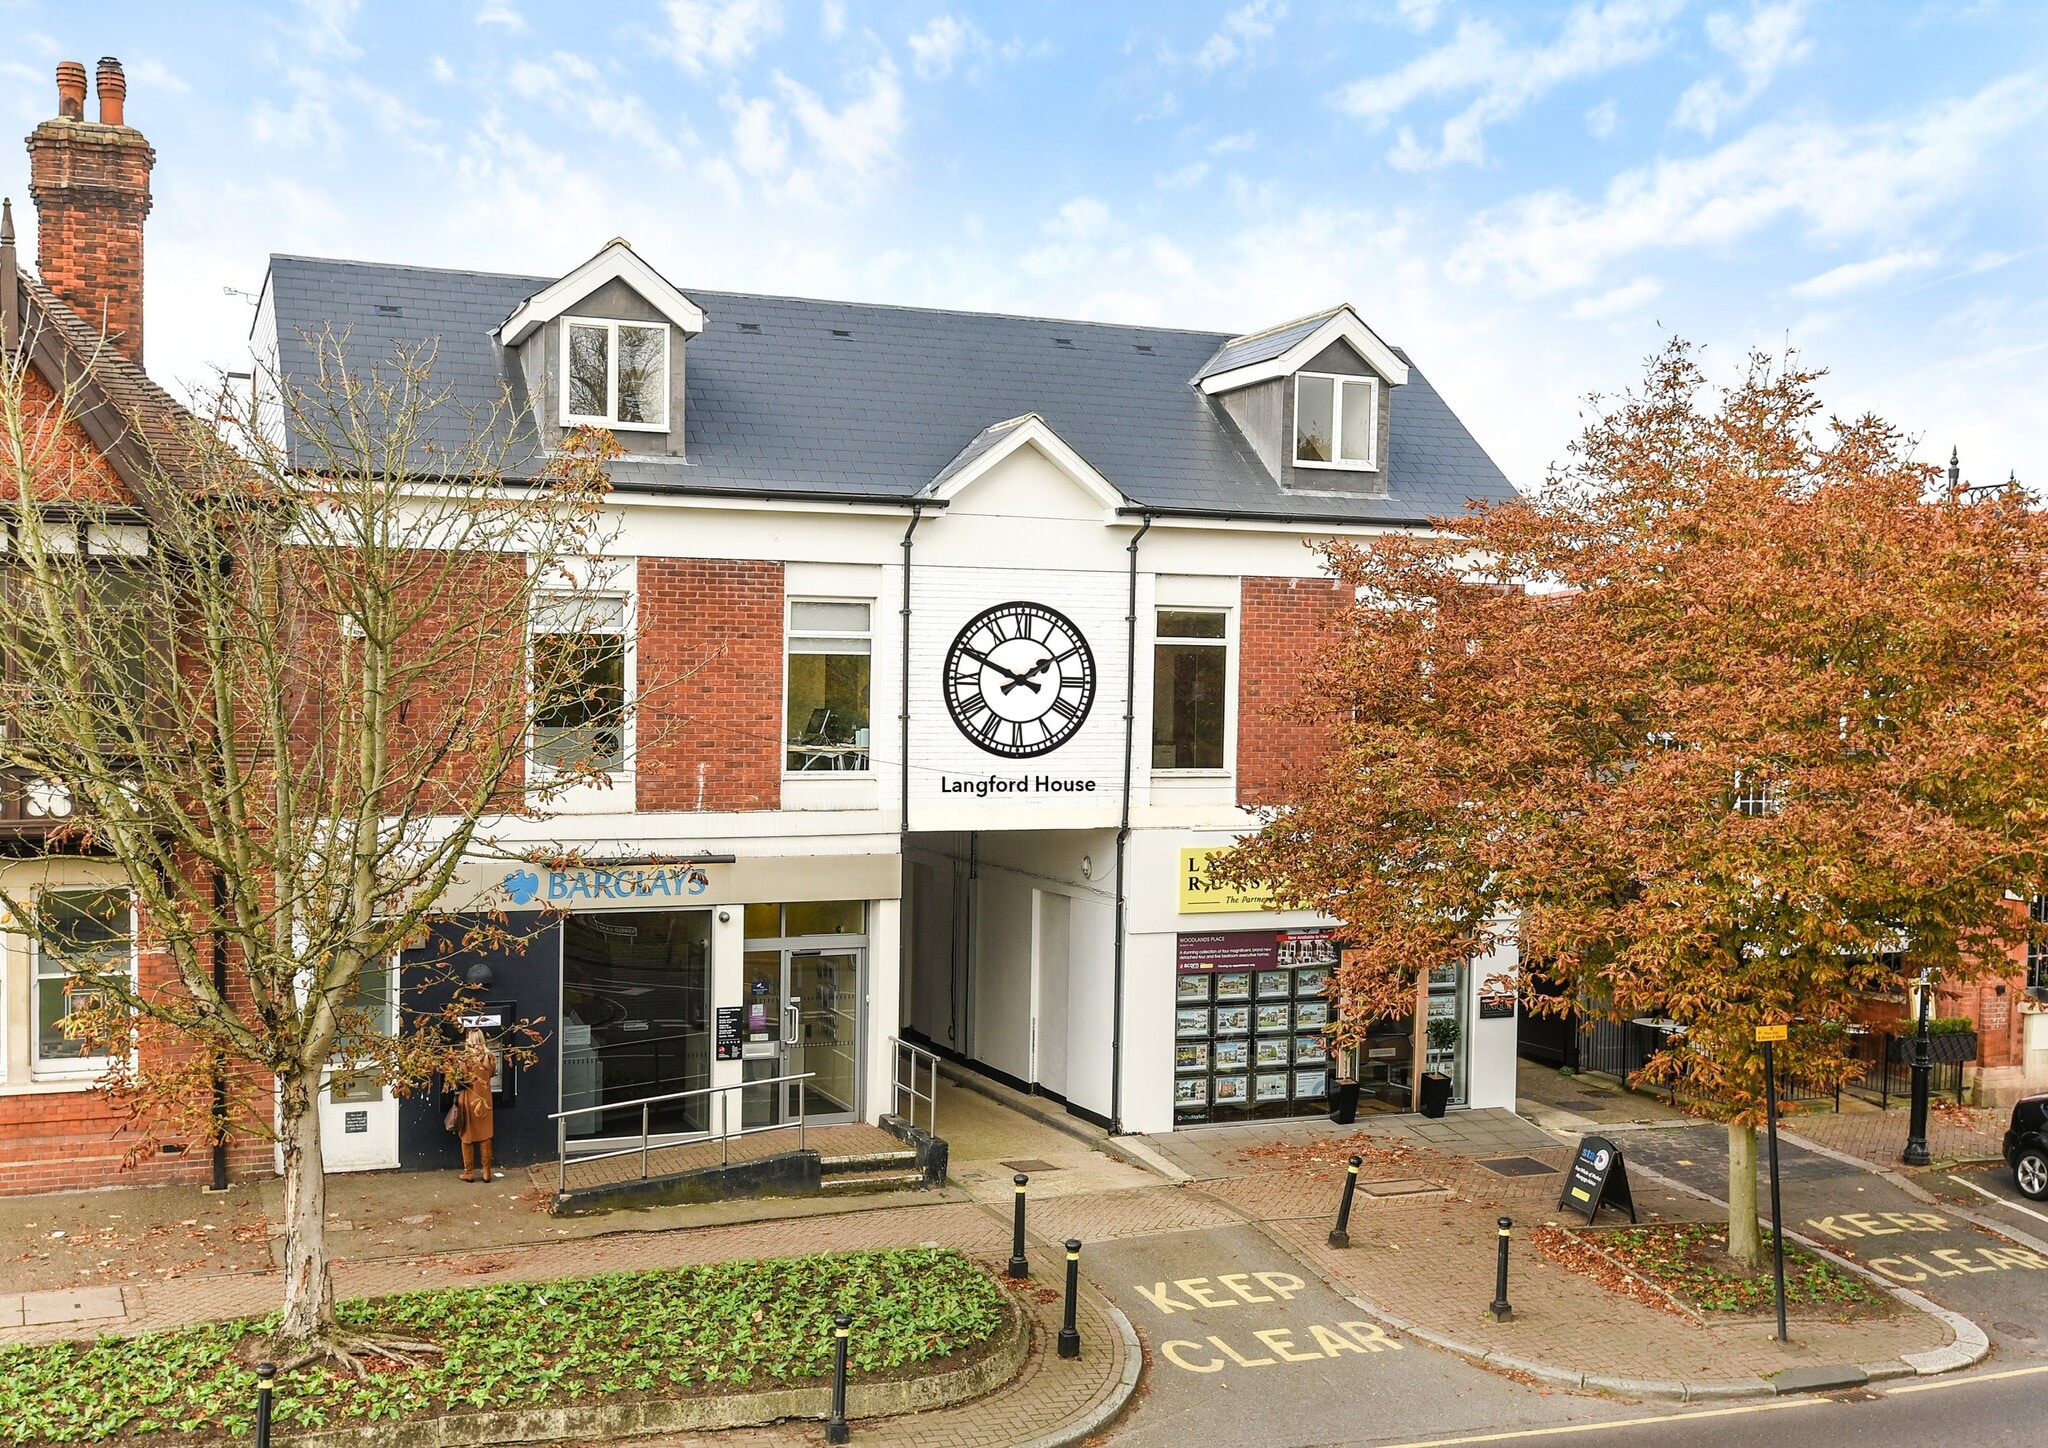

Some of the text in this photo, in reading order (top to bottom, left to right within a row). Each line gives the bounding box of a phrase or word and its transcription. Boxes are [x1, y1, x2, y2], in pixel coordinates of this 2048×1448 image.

[942, 775, 1096, 797] Langford House
[548, 868, 706, 900] BARCLAYS
[1807, 1212, 1951, 1240] KEEP
[1868, 1247, 2048, 1282] CLEAR
[1133, 1271, 1306, 1314] KEEP
[1161, 1320, 1405, 1373] CLEAR
